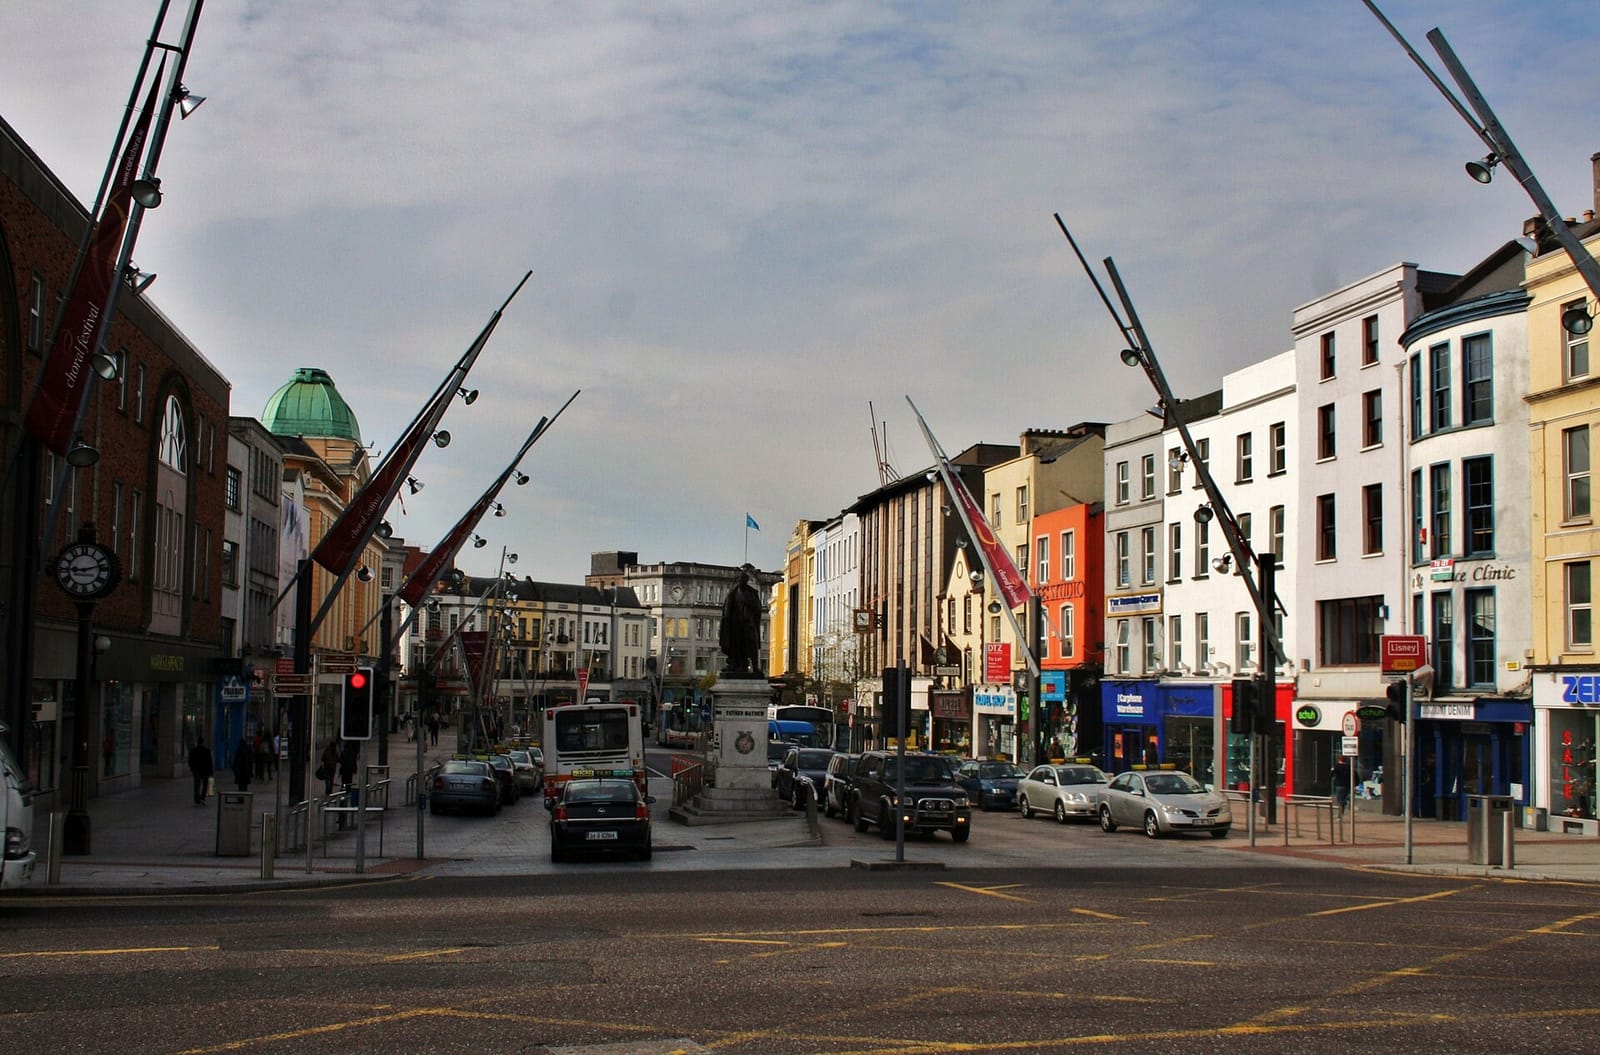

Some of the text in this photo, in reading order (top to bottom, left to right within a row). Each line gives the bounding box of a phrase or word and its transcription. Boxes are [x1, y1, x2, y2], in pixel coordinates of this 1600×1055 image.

[65, 302, 101, 390] choral festival
[1472, 564, 1516, 582] Clinic
[987, 644, 1003, 653] DTZ
[1390, 643, 1416, 653] Lisney
[1298, 709, 1316, 720] schuh
[1447, 704, 1471, 716] DENIM
[1562, 730, 1573, 799] SALE
